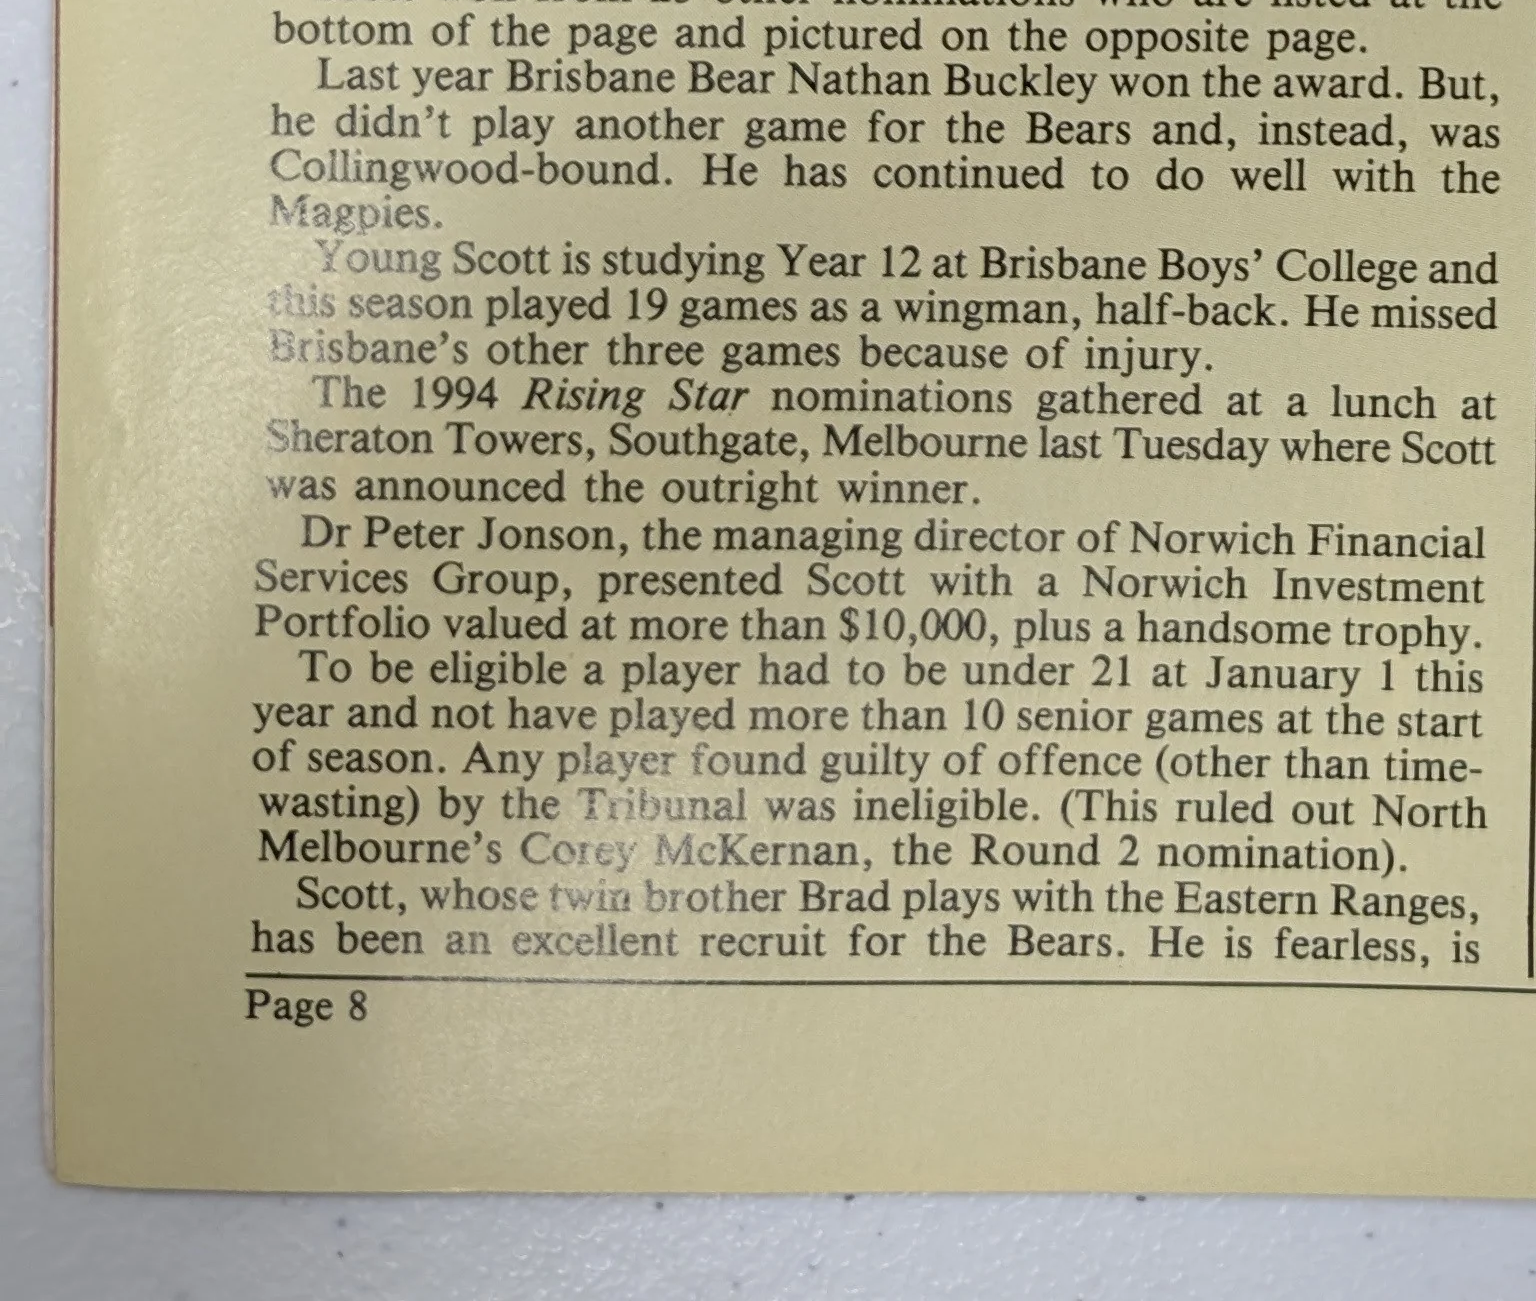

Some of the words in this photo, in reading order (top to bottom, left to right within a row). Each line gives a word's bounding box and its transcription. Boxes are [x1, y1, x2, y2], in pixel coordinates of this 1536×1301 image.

[272, 193, 443, 235] Magpies.
[267, 475, 337, 502] was
[354, 468, 567, 504] announced
[584, 469, 645, 504] the
[661, 468, 819, 511] outright
[837, 469, 980, 505] winner.
[300, 514, 352, 549] Dr
[363, 515, 465, 550] Peter
[477, 515, 629, 558] Jonson,
[642, 516, 702, 552] the
[712, 516, 903, 559] managing
[914, 517, 1066, 553] director
[1076, 519, 1122, 554] of
[1129, 520, 1296, 556] Norwich
[1307, 522, 1486, 560] Financial
[254, 603, 431, 640] Portfolio
[443, 605, 569, 641] valued
[580, 611, 618, 641] at
[629, 616, 729, 642] more
[740, 606, 827, 642] than
[839, 605, 999, 648] $10,000,
[1012, 608, 1091, 649] plus
[1103, 618, 1125, 643] a
[1136, 608, 1331, 646] handsome
[1342, 614, 1482, 656] trophy.
[244, 988, 334, 1029] Page
[348, 989, 368, 1022] 8
